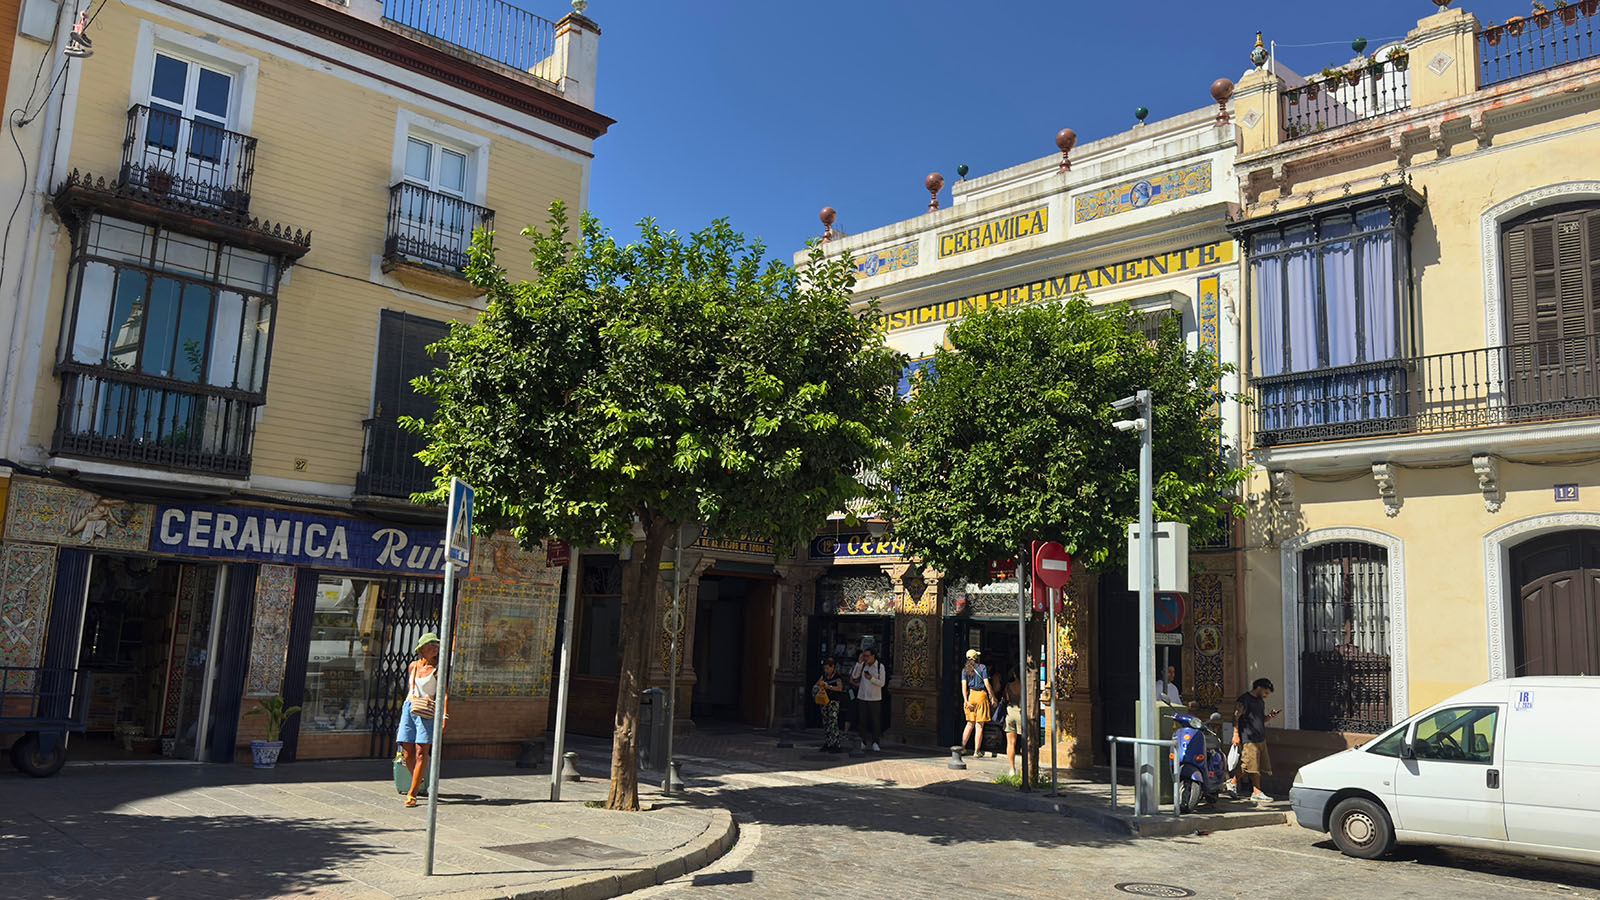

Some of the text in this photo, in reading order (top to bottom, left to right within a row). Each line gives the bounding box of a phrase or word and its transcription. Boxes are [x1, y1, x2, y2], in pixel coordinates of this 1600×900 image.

[941, 210, 1044, 257] CERAMICA
[986, 242, 1220, 305] PERMANENTE
[1559, 487, 1575, 498] 12
[159, 508, 349, 560] CERAMICA
[711, 539, 739, 550] AZLEJOS
[847, 535, 906, 556] CERA
[1519, 691, 1529, 702] IR
